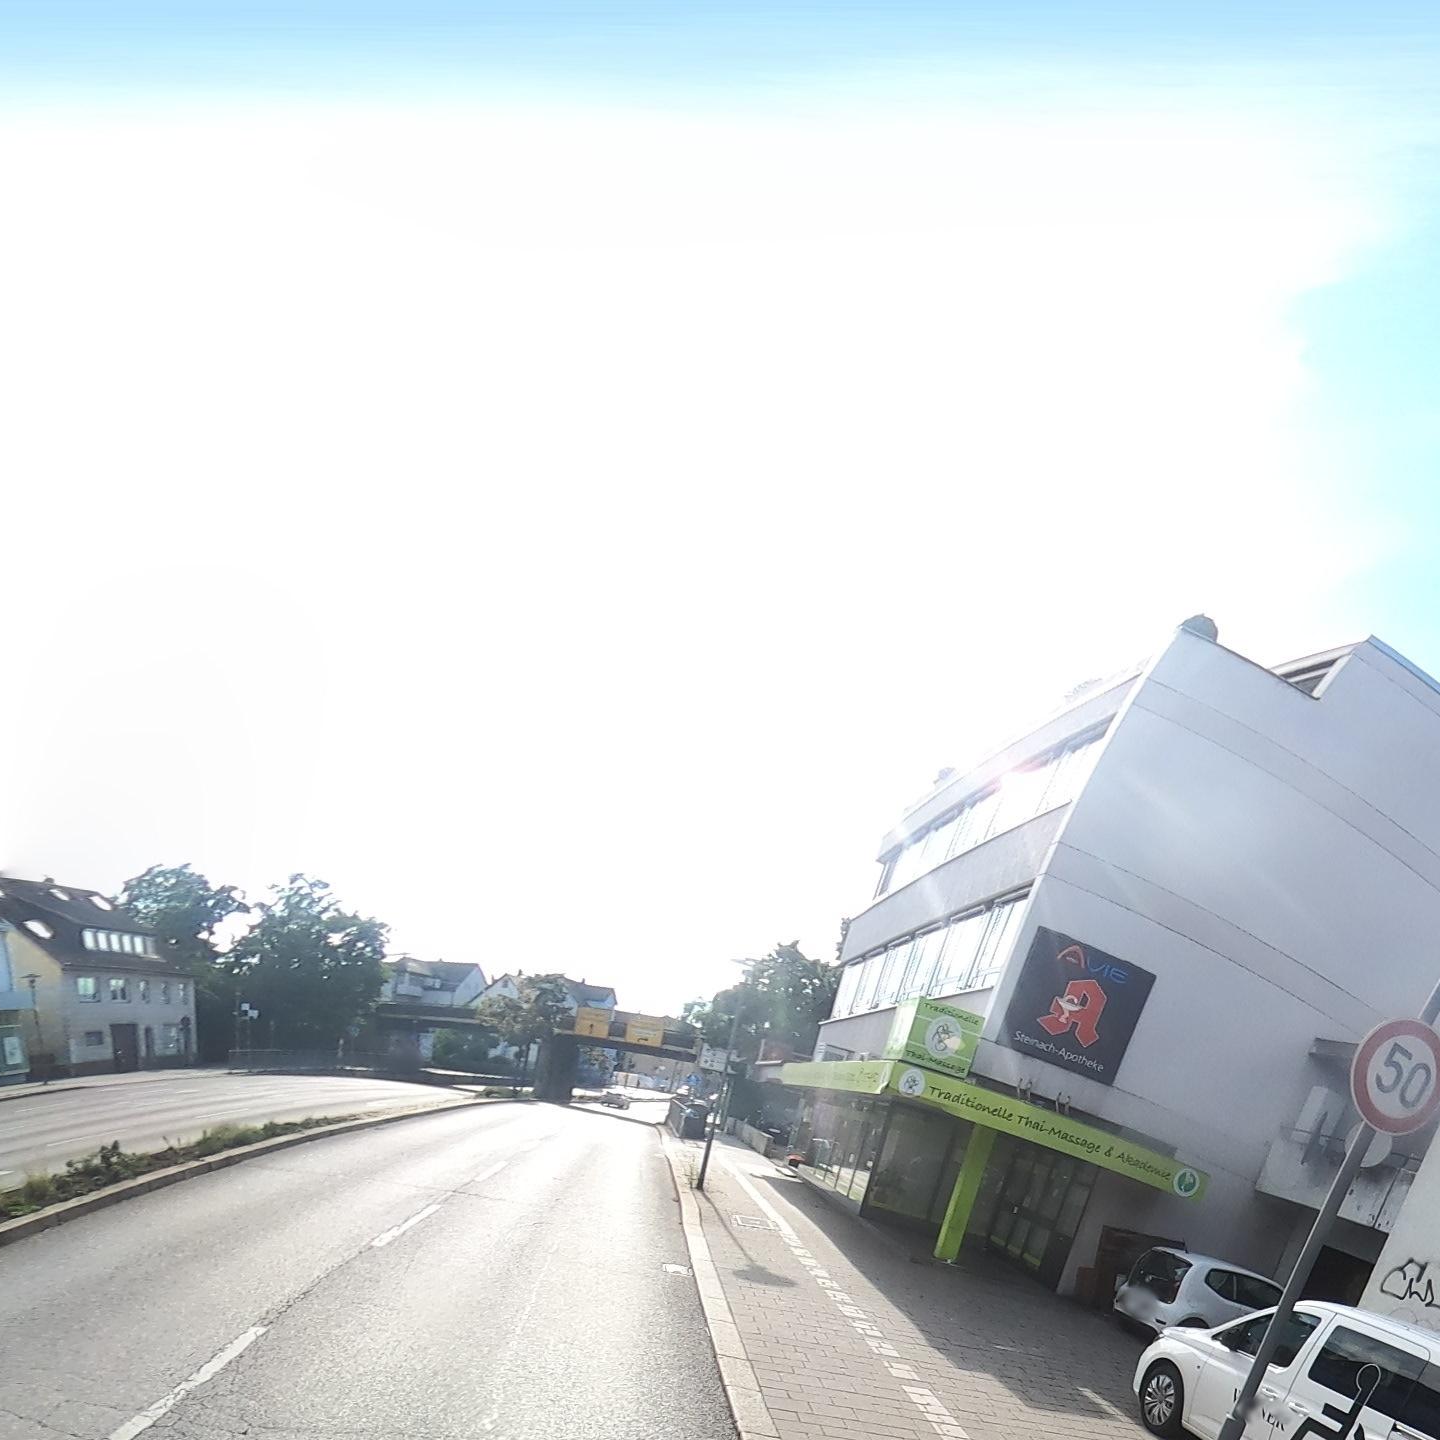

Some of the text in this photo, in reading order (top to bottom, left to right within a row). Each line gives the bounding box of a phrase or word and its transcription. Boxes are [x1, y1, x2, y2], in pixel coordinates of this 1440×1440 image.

[1013, 1031, 1104, 1072] Steinach-Apotheke
[1375, 1042, 1431, 1108] 50
[929, 1086, 1013, 1122] Traditionelle
[1017, 1115, 1101, 1153] Thai-Massage
[1117, 1152, 1172, 1181] Akademie
